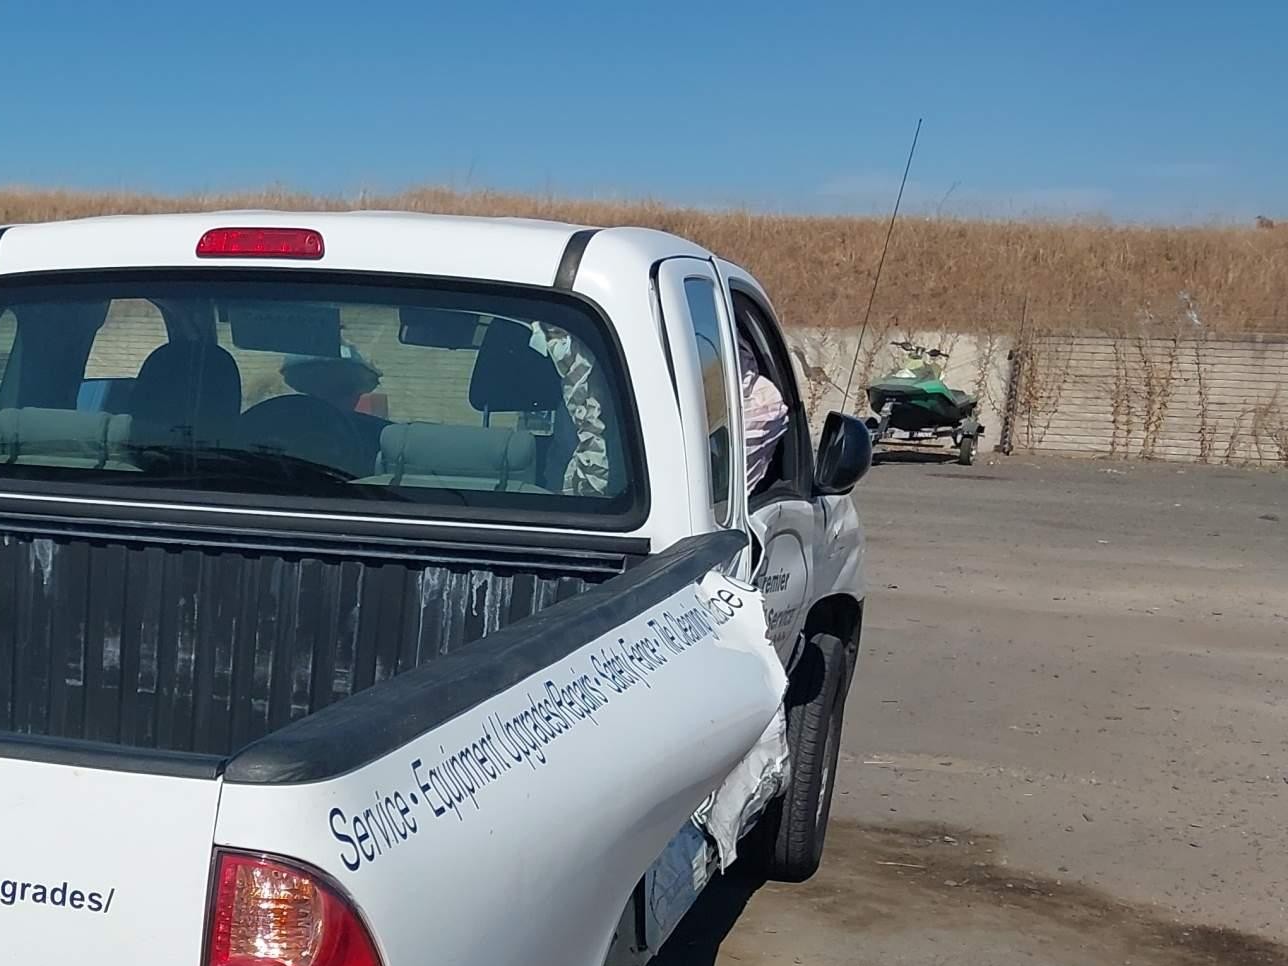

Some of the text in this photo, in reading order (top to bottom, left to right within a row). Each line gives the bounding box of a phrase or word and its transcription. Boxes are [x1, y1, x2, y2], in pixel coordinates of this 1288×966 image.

[591, 648, 651, 693] Safety
[618, 637, 668, 675] Fence
[411, 721, 511, 821] Equipment
[329, 788, 417, 871] Service
